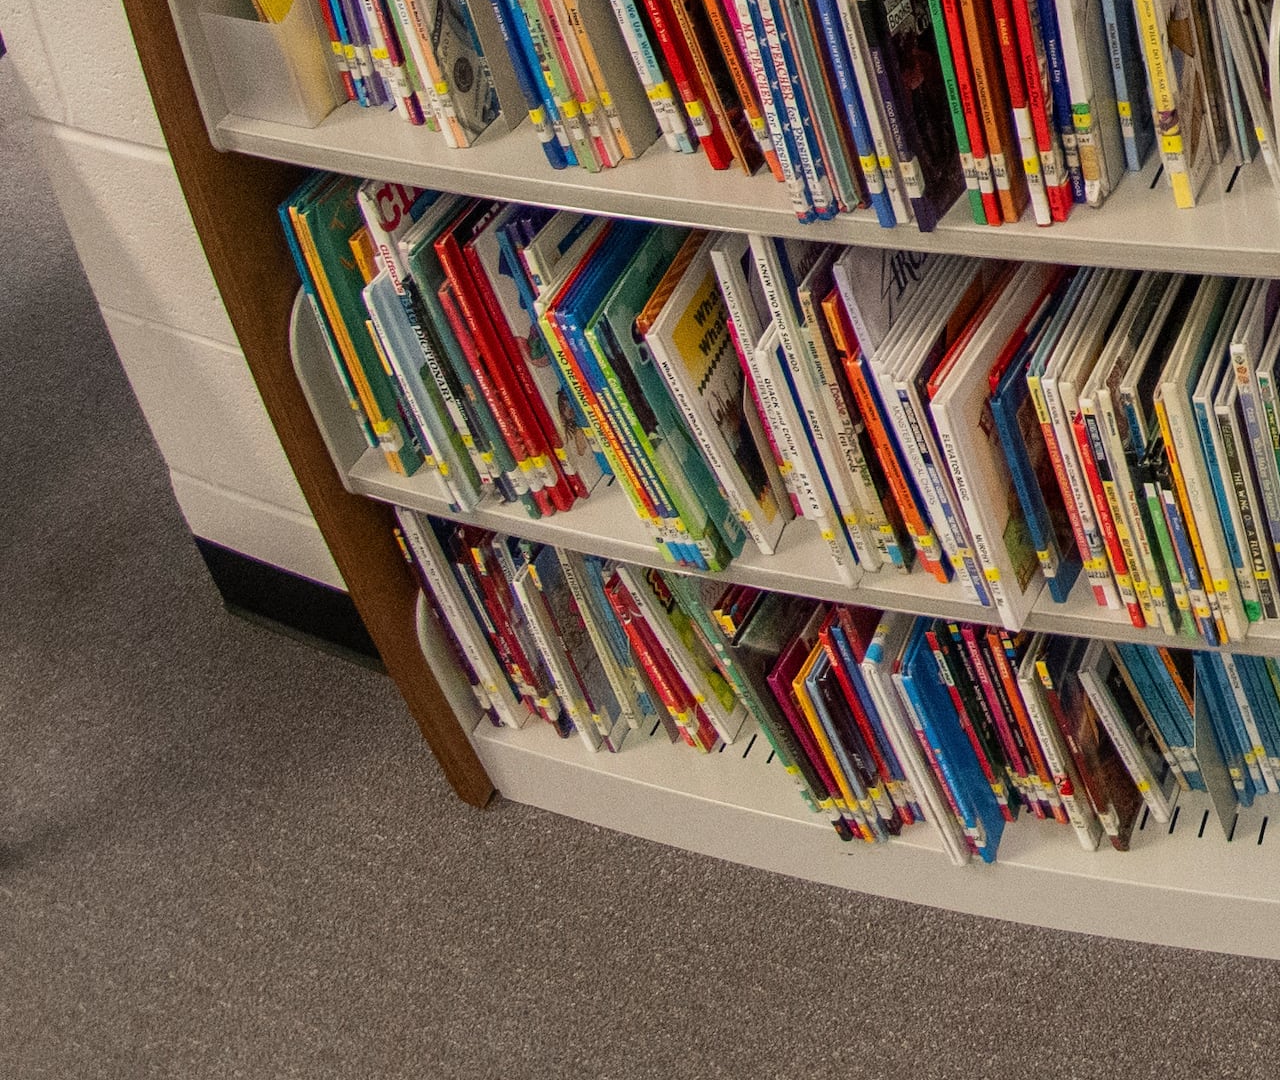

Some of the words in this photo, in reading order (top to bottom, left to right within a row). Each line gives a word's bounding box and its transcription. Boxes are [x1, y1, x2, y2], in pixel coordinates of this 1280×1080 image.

[763, 377, 780, 412] QUACK
[775, 411, 786, 427] and
[781, 425, 799, 457] COUNT
[799, 472, 820, 511] BAKER
[941, 432, 963, 480] ELEVATOR
[954, 473, 970, 502] MAGIC
[974, 533, 992, 566] MURPHY
